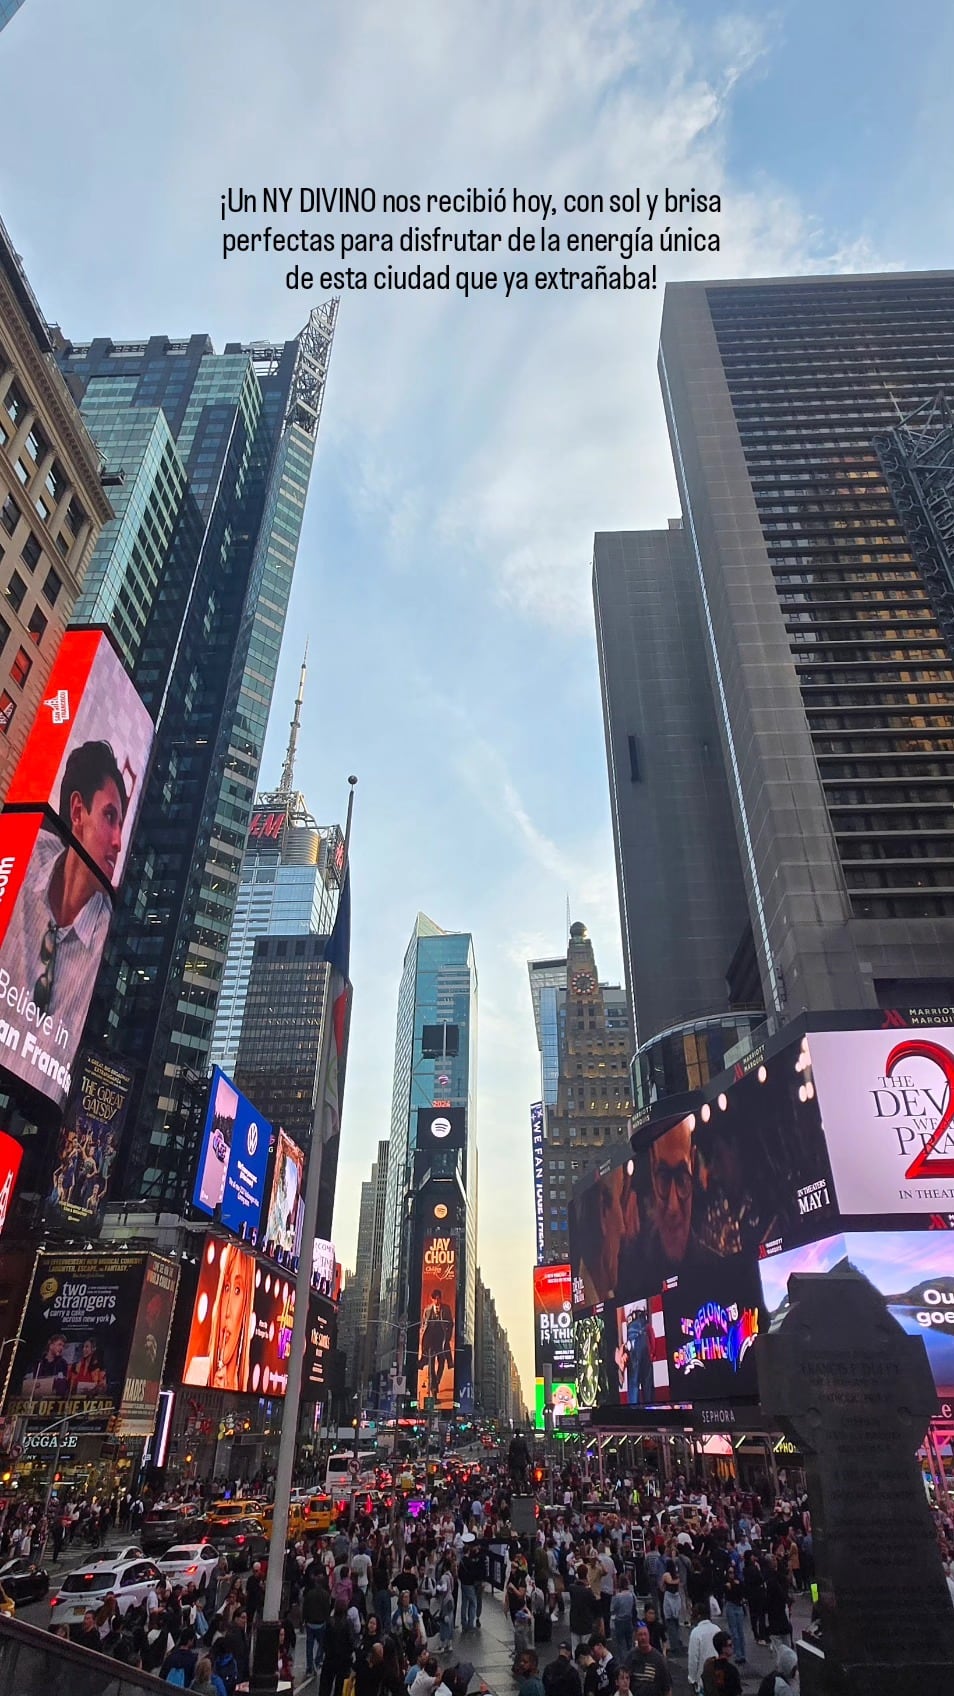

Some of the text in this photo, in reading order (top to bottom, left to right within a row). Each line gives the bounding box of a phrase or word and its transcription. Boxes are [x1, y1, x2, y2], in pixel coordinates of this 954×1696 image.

[0, 967, 69, 1049] Believe in
[877, 1075, 915, 1088] THE
[81, 1076, 98, 1097] THE
[97, 1085, 126, 1110] GREAT
[82, 1095, 118, 1120] GATSBY
[533, 1121, 543, 1144] WE
[534, 1147, 544, 1179] FAN
[797, 1187, 831, 1215] MAY 1
[898, 1190, 913, 1199] IN
[430, 1237, 451, 1251] JAY
[424, 1250, 455, 1264] CHOU
[62, 1281, 87, 1296] two
[54, 1295, 117, 1312] strangers
[50, 1310, 65, 1318] carry
[96, 1314, 110, 1324] york
[540, 1329, 551, 1346] IS
[39, 1400, 55, 1416] OF
[56, 1400, 81, 1416] THE
[83, 1400, 113, 1415] YEAR
[701, 1410, 736, 1423] SEPHORA
